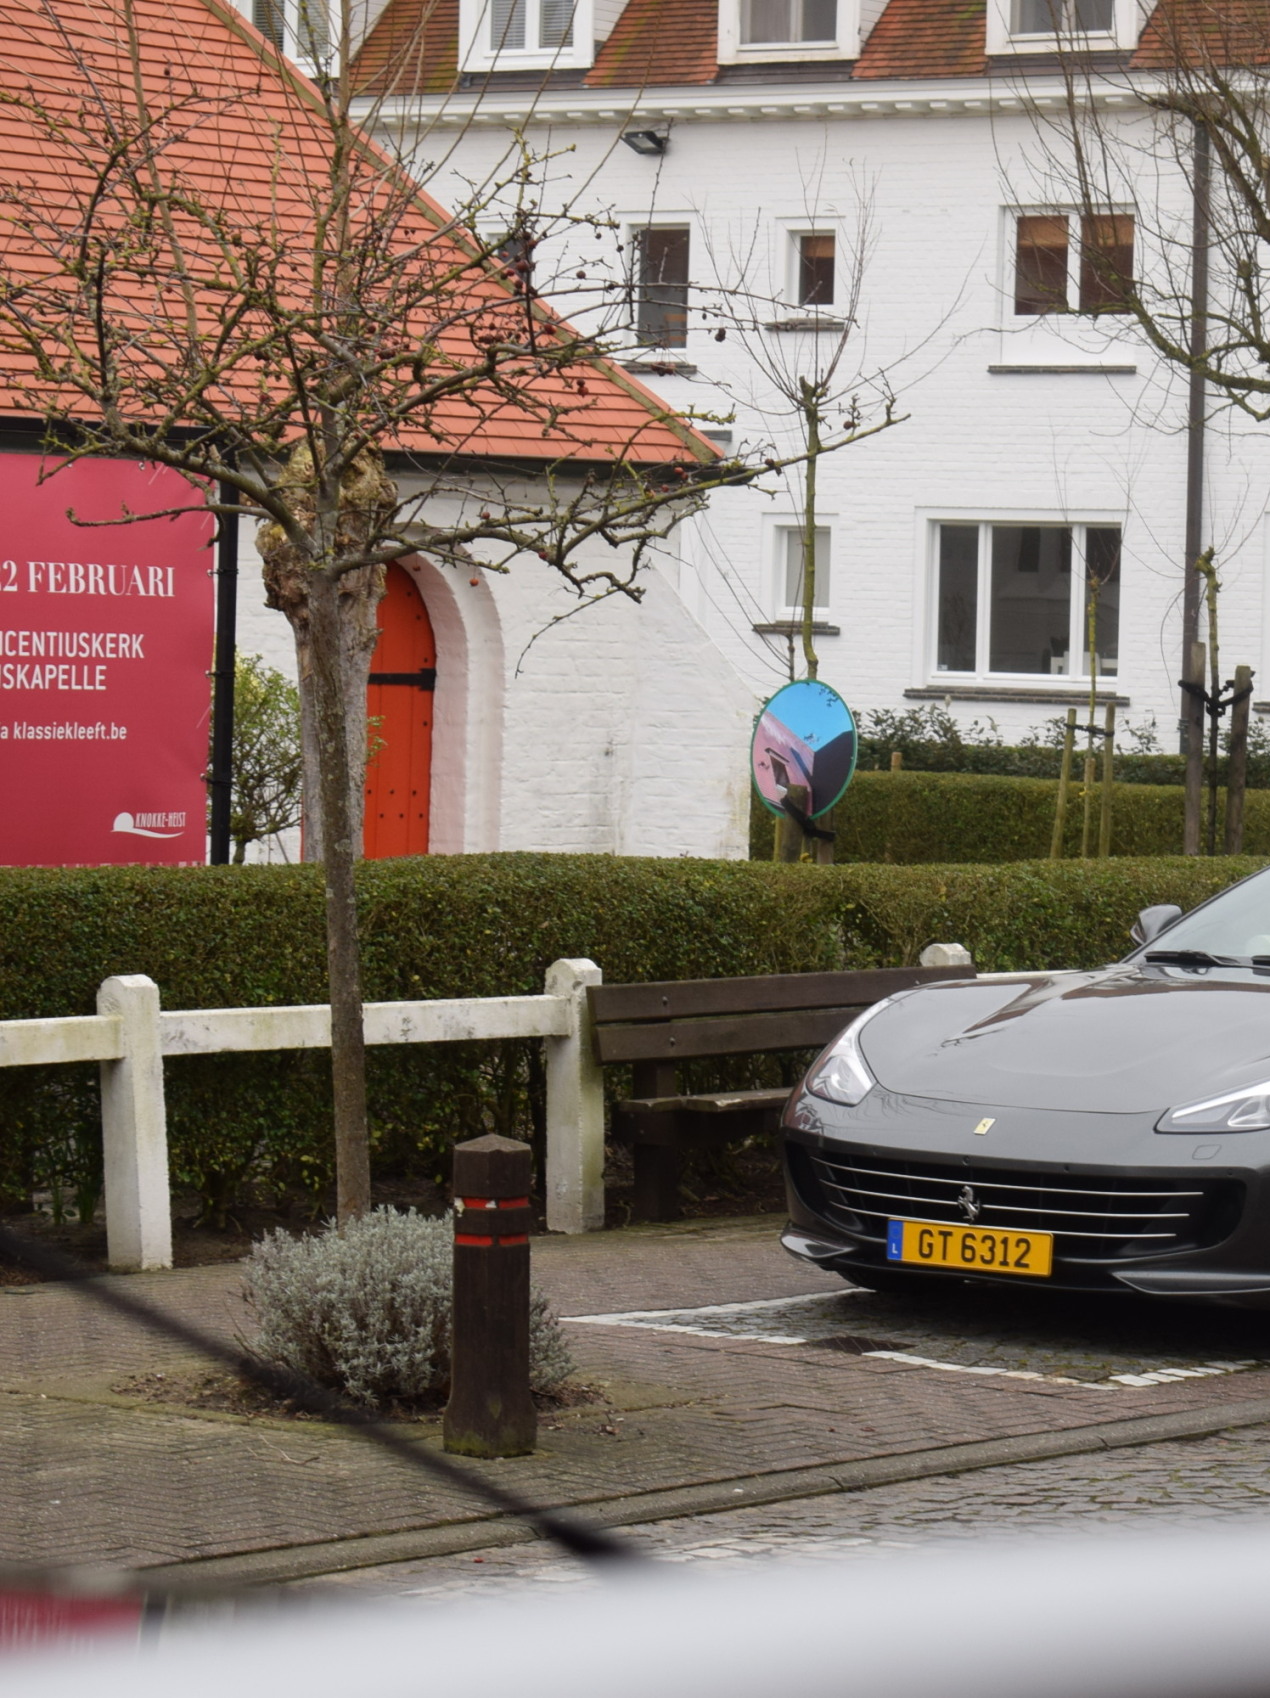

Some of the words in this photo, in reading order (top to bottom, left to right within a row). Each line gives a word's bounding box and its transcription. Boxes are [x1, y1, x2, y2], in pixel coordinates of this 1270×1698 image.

[0, 560, 18, 592] 2
[26, 561, 175, 597] FEBRUARI
[0, 664, 107, 691] SKAPELLE
[13, 721, 127, 741] klassiekleeft.be
[135, 811, 187, 828] KNOKKE-HEIST
[891, 1242, 899, 1254] L
[918, 1229, 953, 1261] GT
[960, 1232, 1032, 1269] 6312
